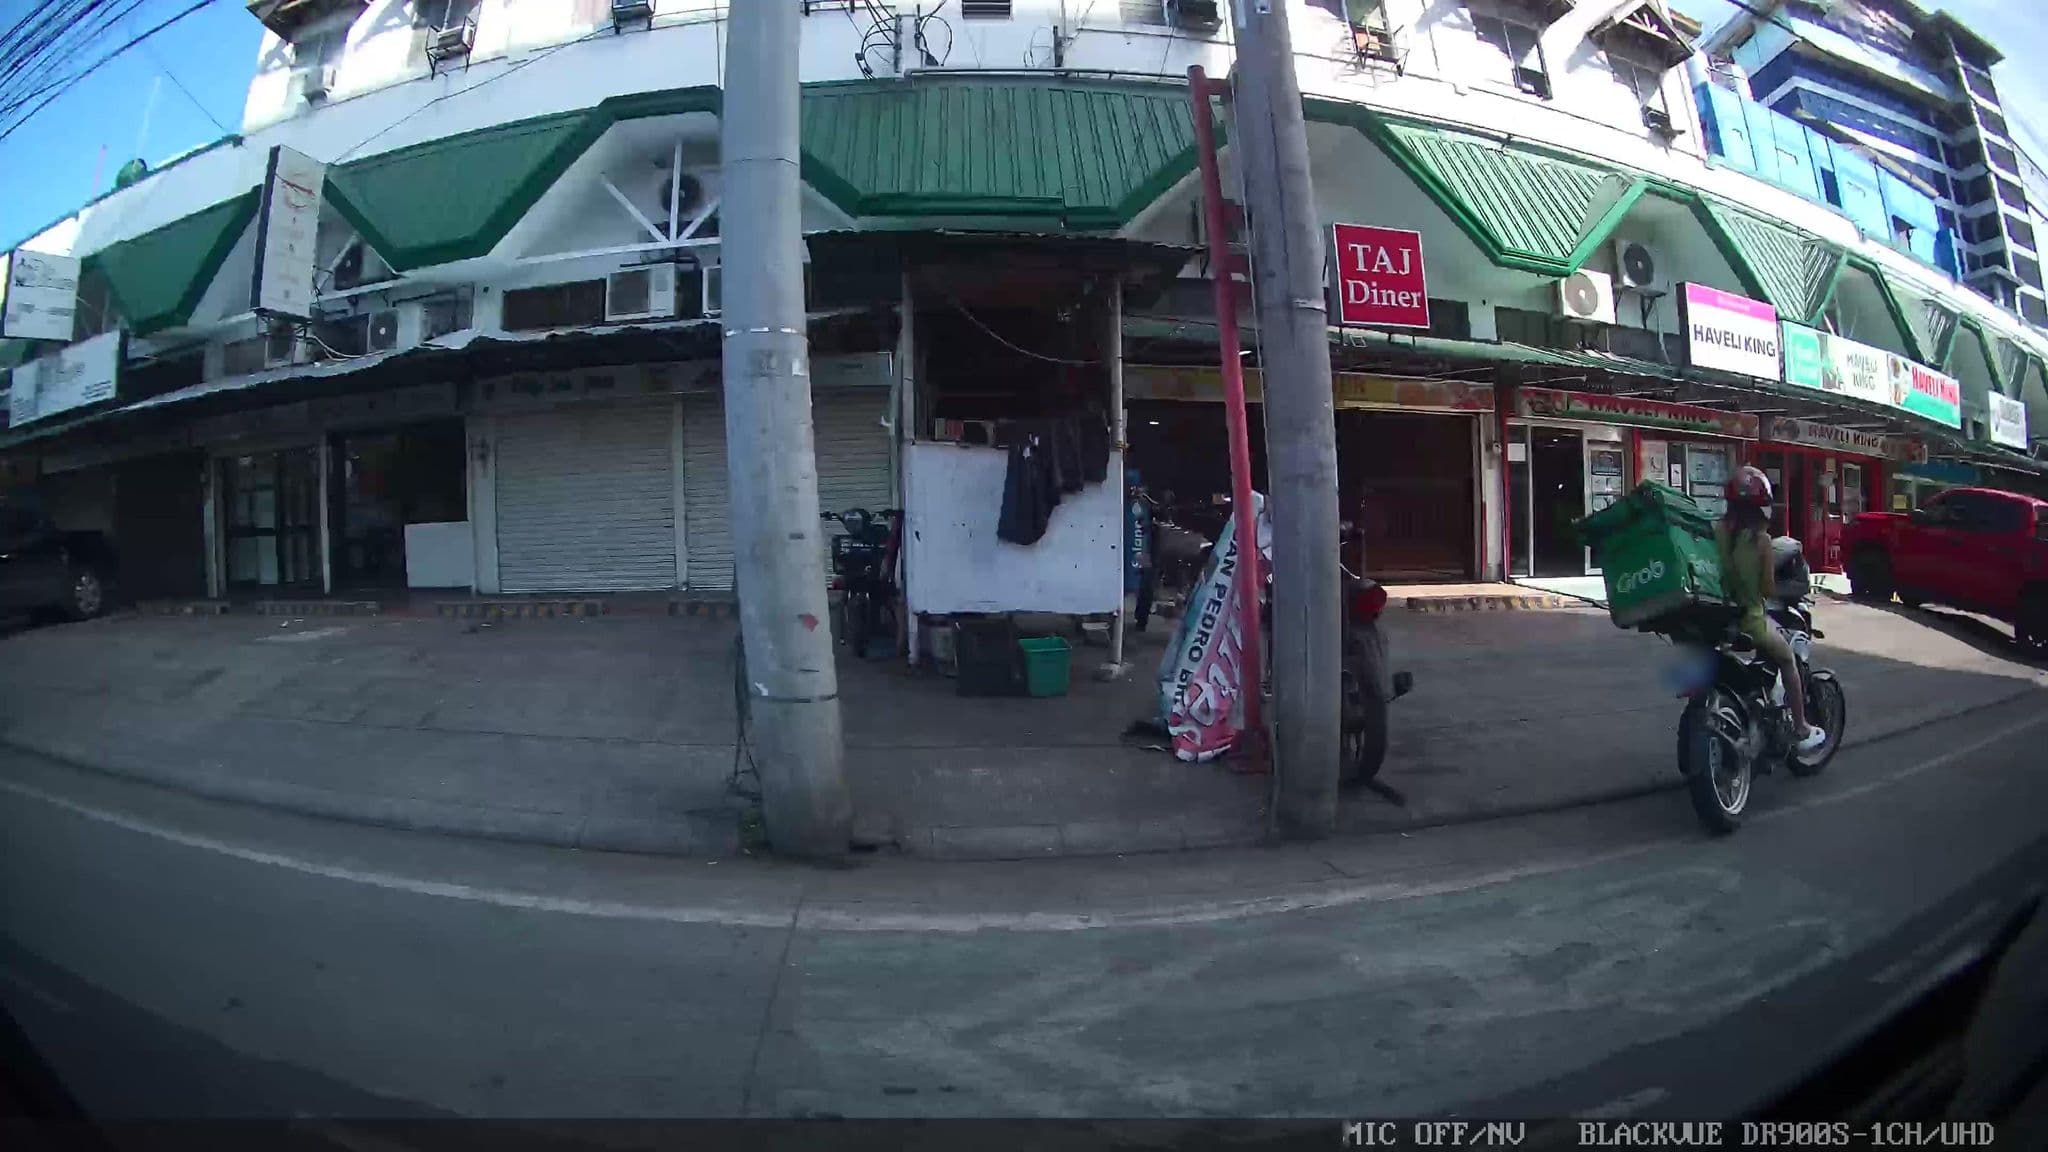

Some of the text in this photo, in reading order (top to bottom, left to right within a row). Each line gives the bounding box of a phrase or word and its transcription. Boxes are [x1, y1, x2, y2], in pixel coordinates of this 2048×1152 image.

[1348, 242, 1412, 275] TAJ
[1346, 279, 1422, 308] Diner
[1693, 323, 1776, 358] HAVELI KING
[1188, 582, 1229, 663] PEDRO
